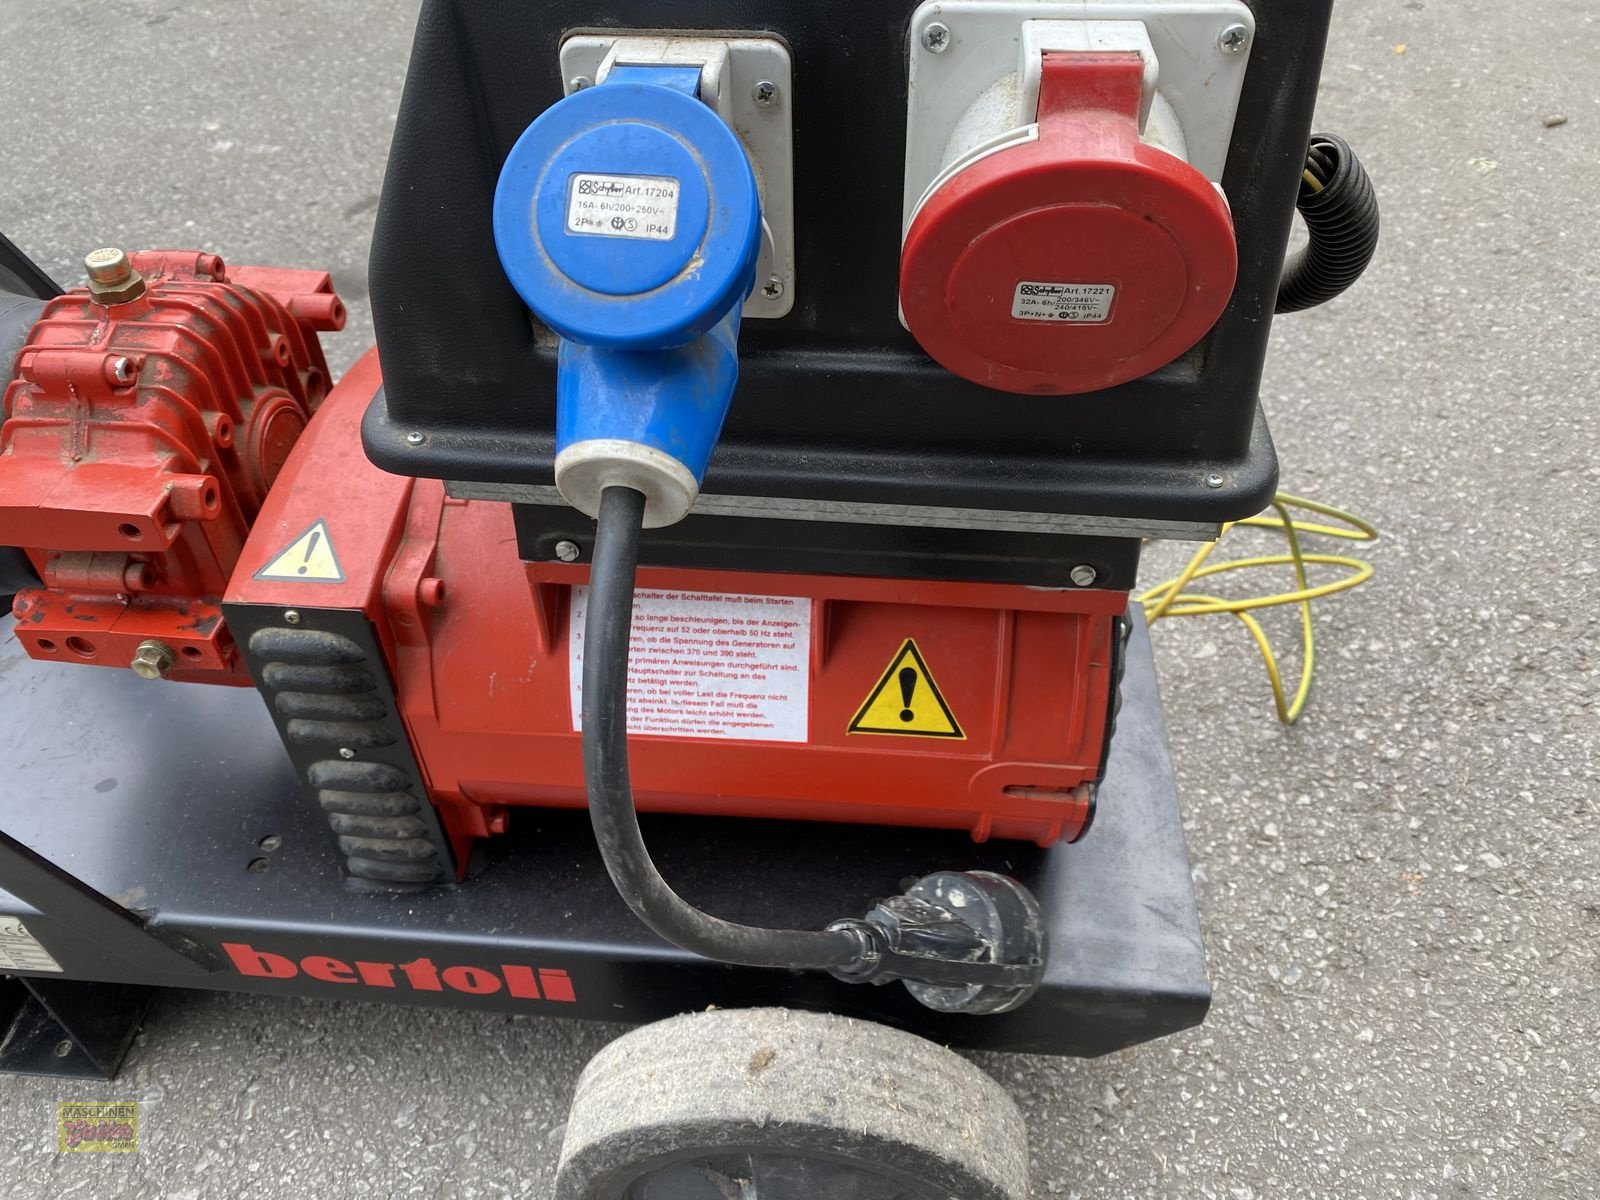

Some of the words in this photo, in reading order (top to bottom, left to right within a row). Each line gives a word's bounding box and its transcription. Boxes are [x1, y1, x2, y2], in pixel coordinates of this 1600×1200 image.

[646, 224, 668, 234] IP44
[681, 594, 722, 602] Schalttafel
[647, 615, 668, 623] lange
[674, 638, 713, 647] Spannung
[732, 640, 780, 649] Generatoren
[727, 662, 778, 671] durchgeführt
[699, 670, 738, 680] Schaltung
[730, 692, 766, 700] Frequenz
[220, 942, 577, 1002] bertoli
